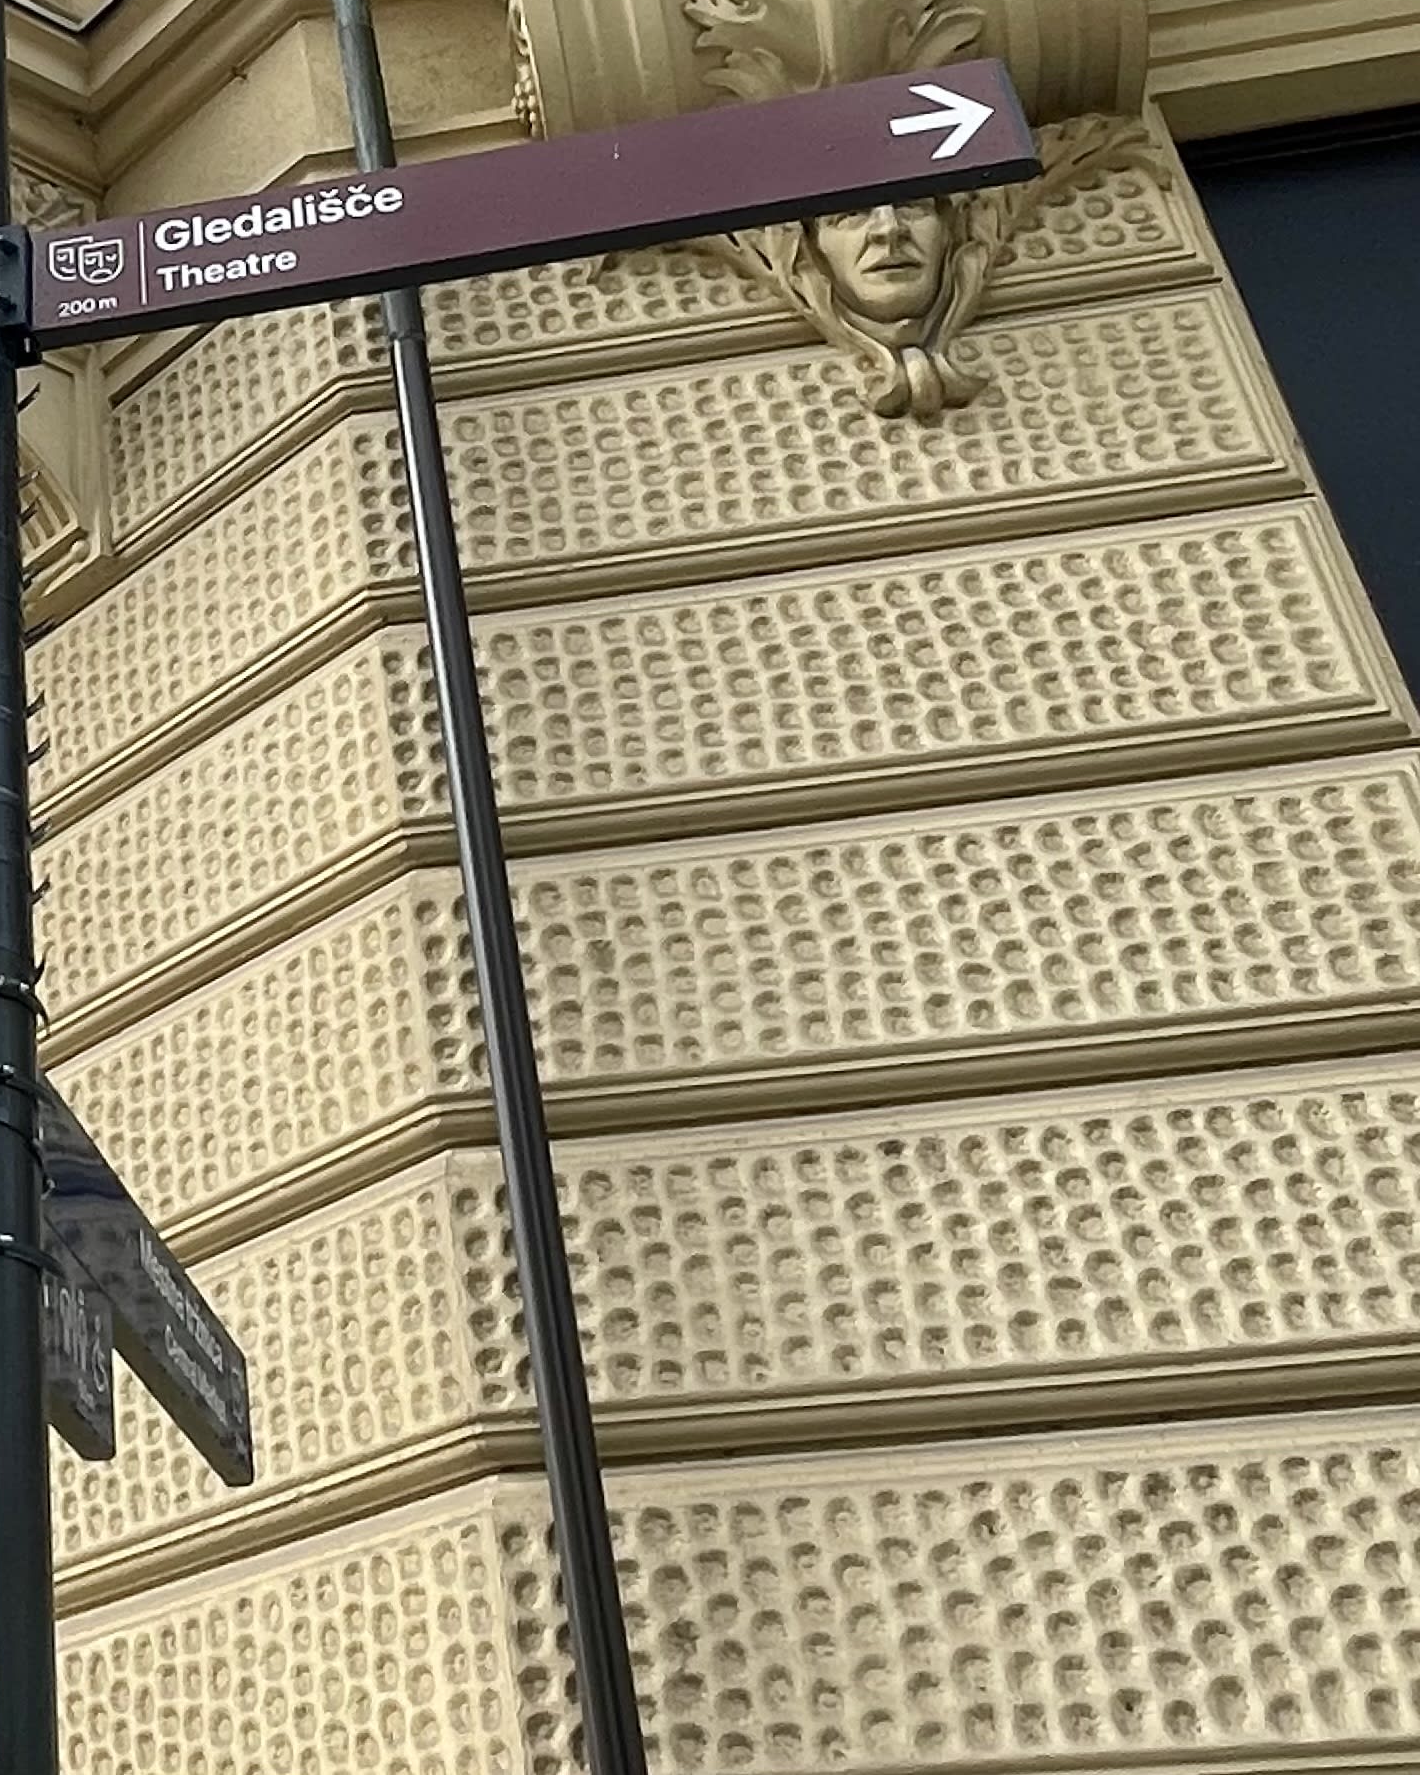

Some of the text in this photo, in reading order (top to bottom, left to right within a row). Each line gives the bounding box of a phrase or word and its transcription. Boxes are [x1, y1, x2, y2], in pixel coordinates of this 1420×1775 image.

[154, 182, 403, 252] Gledališče
[155, 250, 297, 291] Theatre
[57, 296, 118, 318] 200 m
